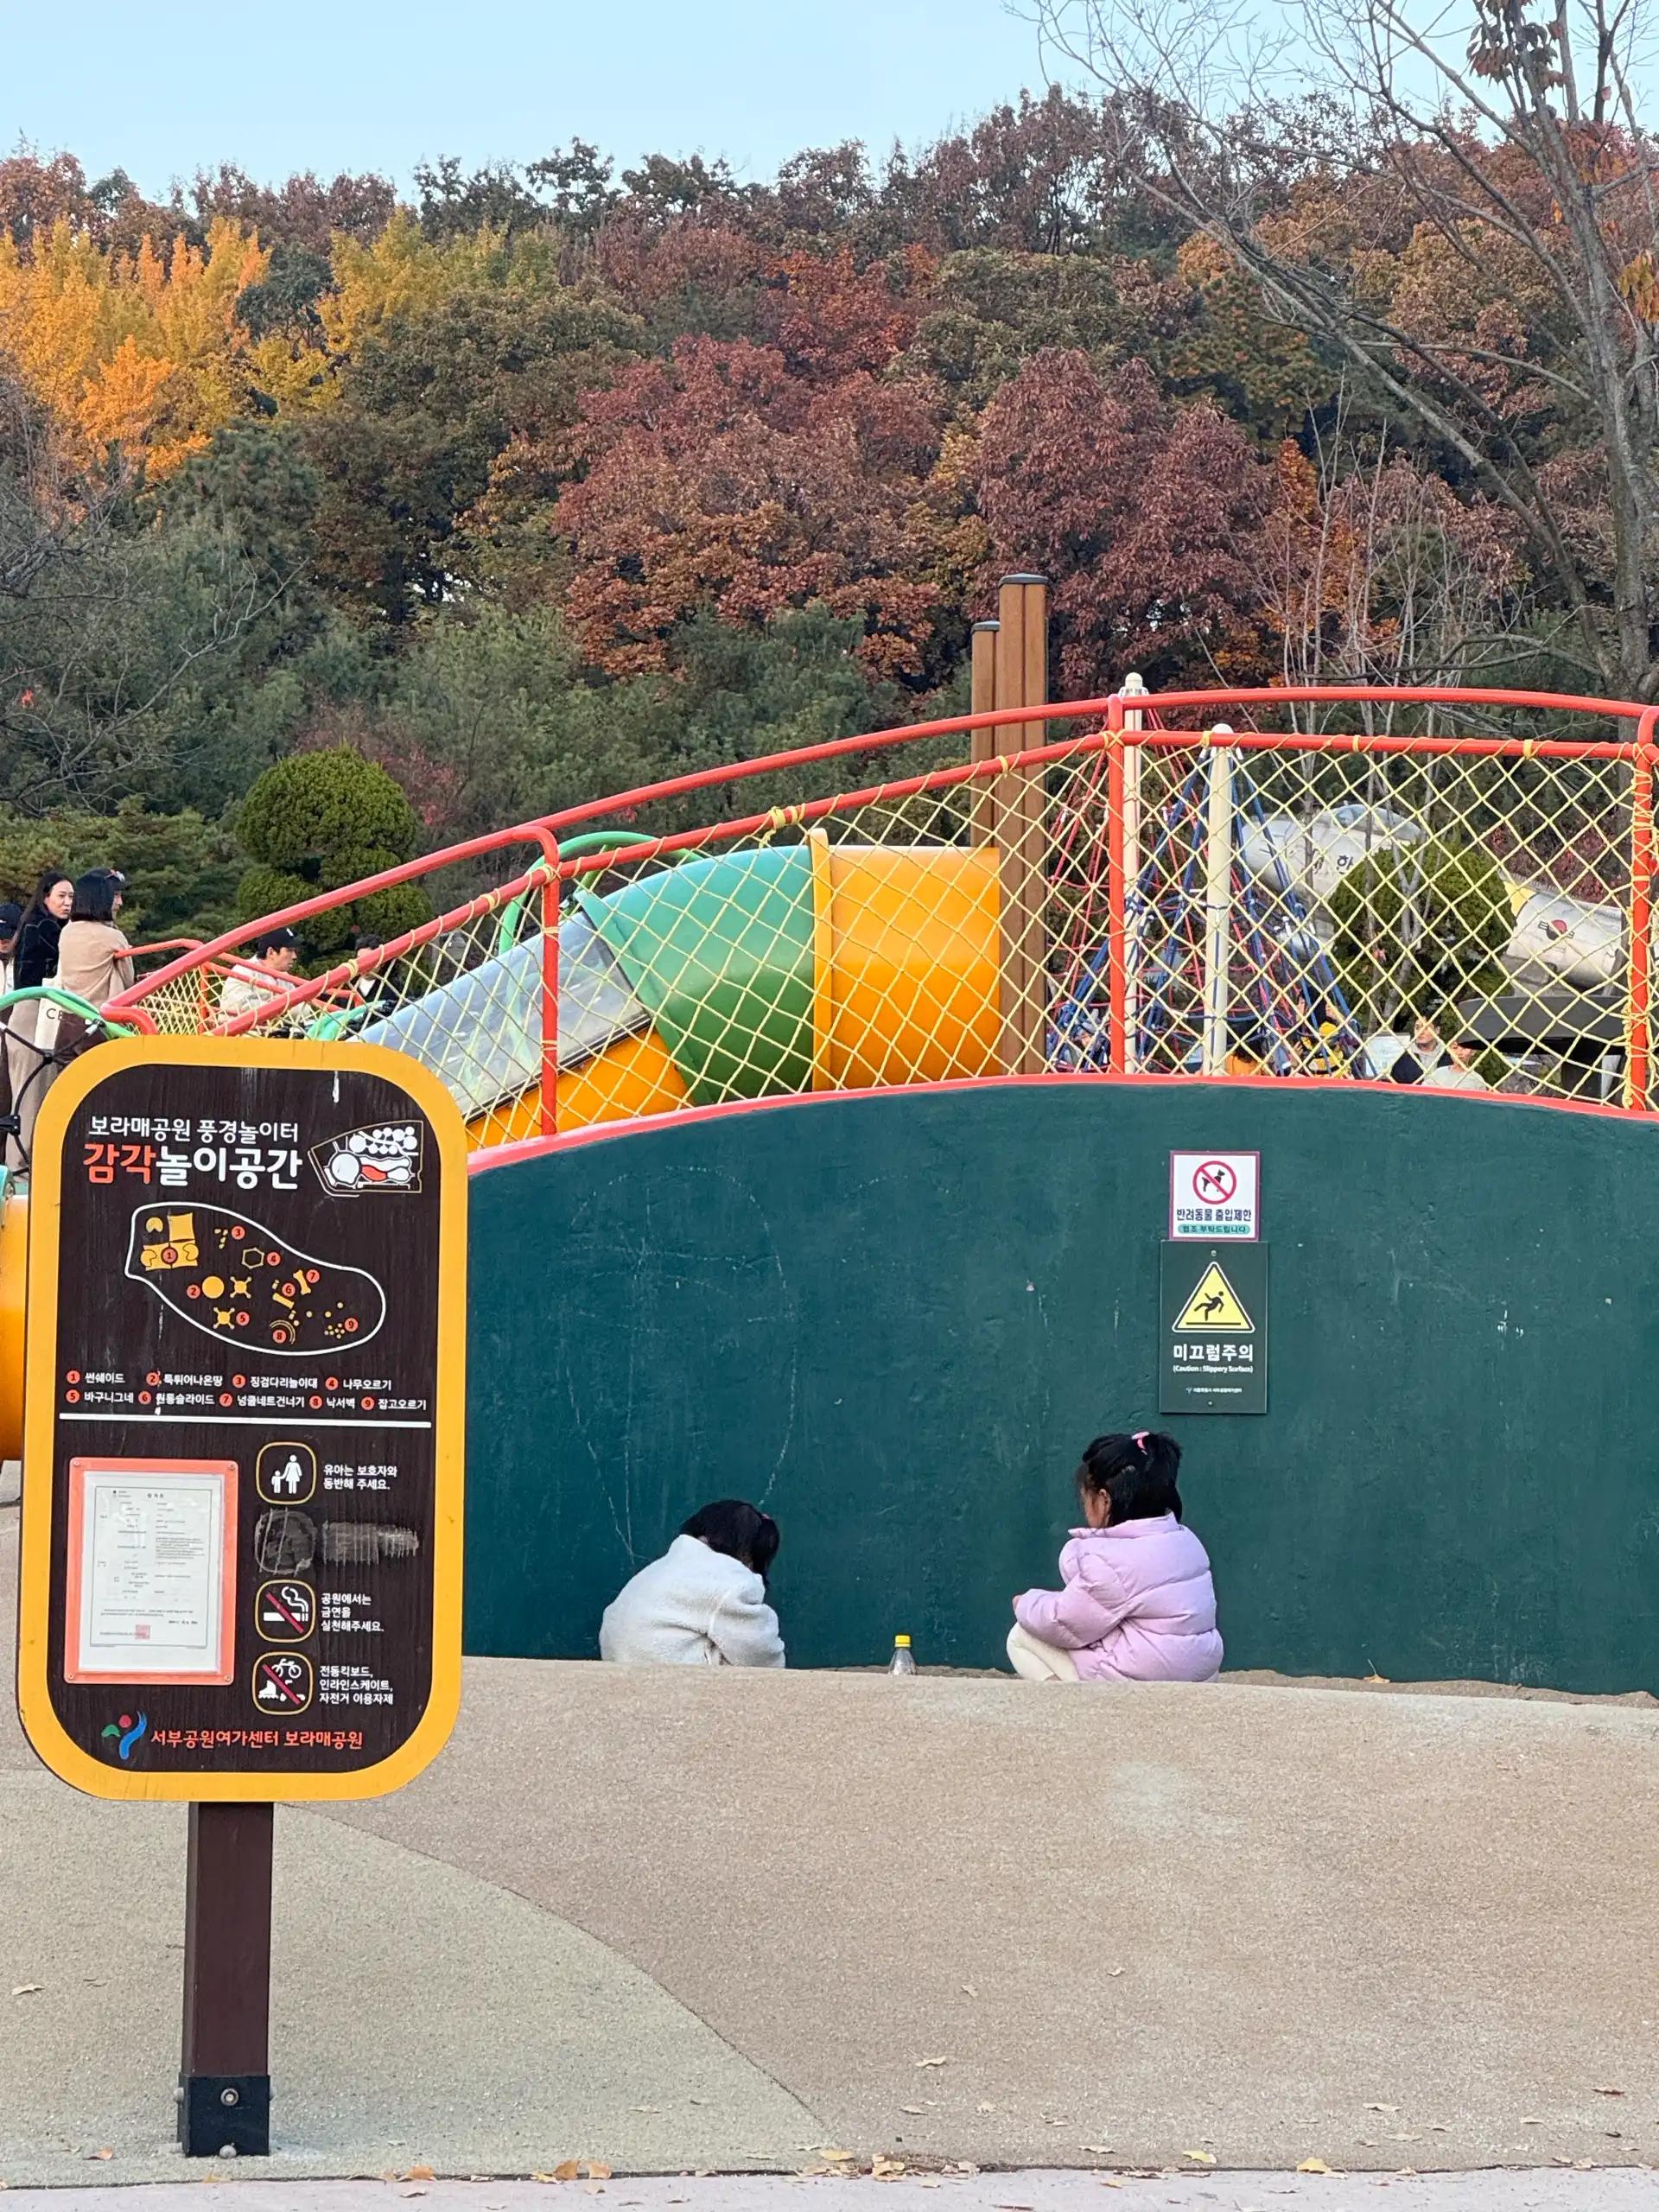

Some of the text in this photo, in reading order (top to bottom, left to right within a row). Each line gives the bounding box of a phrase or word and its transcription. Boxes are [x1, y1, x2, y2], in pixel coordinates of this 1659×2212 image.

[88, 1116, 299, 1145] 보라매공원 풍경놀이터
[83, 1143, 303, 1190] 감각놀이공간
[1176, 1208, 1252, 1222] 반려동물 출입제한
[1173, 1344, 1254, 1362] 미끄럼주의
[1203, 1365, 1228, 1374] Slippery
[250, 1376, 318, 1389] 징검다리놀이대
[343, 1378, 391, 1391] 나무오르기
[84, 1391, 134, 1404] 바구니그네
[156, 1392, 215, 1406] 원통슬라이드
[237, 1395, 305, 1408] 넝쿨네트건너기
[326, 1396, 355, 1409] 낙서벽
[378, 1398, 427, 1411] 잡고오르기
[323, 1464, 397, 1478] 유아는 보호자와
[323, 1478, 391, 1491] 동반해 주세요.
[321, 1592, 372, 1605] 공원에서는
[321, 1606, 351, 1618] 금연을
[321, 1619, 385, 1632] 실천해주세요.
[319, 1665, 373, 1678] 전동킥보드,
[319, 1679, 393, 1692] 인라인스케이트,
[319, 1692, 394, 1706] 자전거 이용자제
[150, 1729, 364, 1750] 서부공원여가센터 보라매공원
